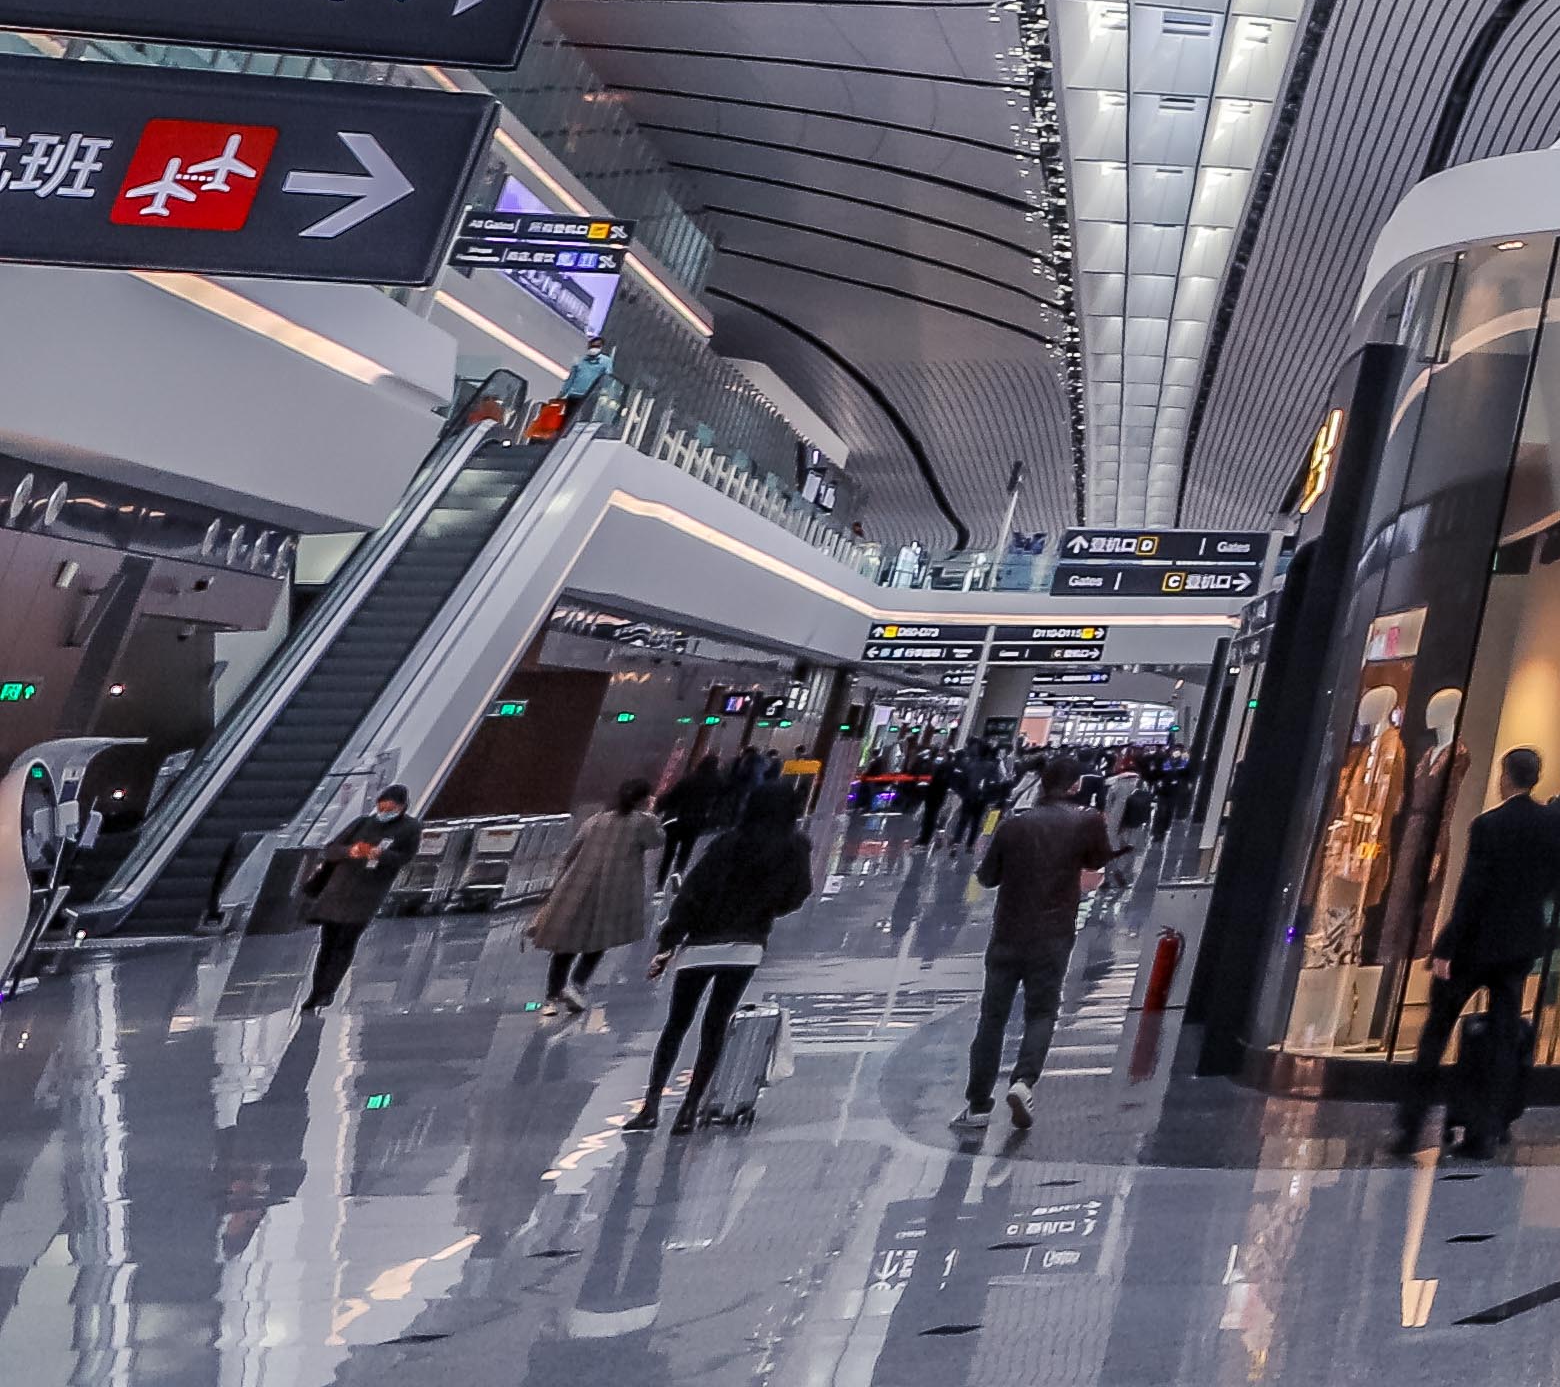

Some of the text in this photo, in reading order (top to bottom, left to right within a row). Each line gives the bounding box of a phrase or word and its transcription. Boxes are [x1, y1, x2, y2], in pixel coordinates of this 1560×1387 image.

[1089, 537, 1137, 553] 登机口
[1184, 574, 1232, 590] 登机口
